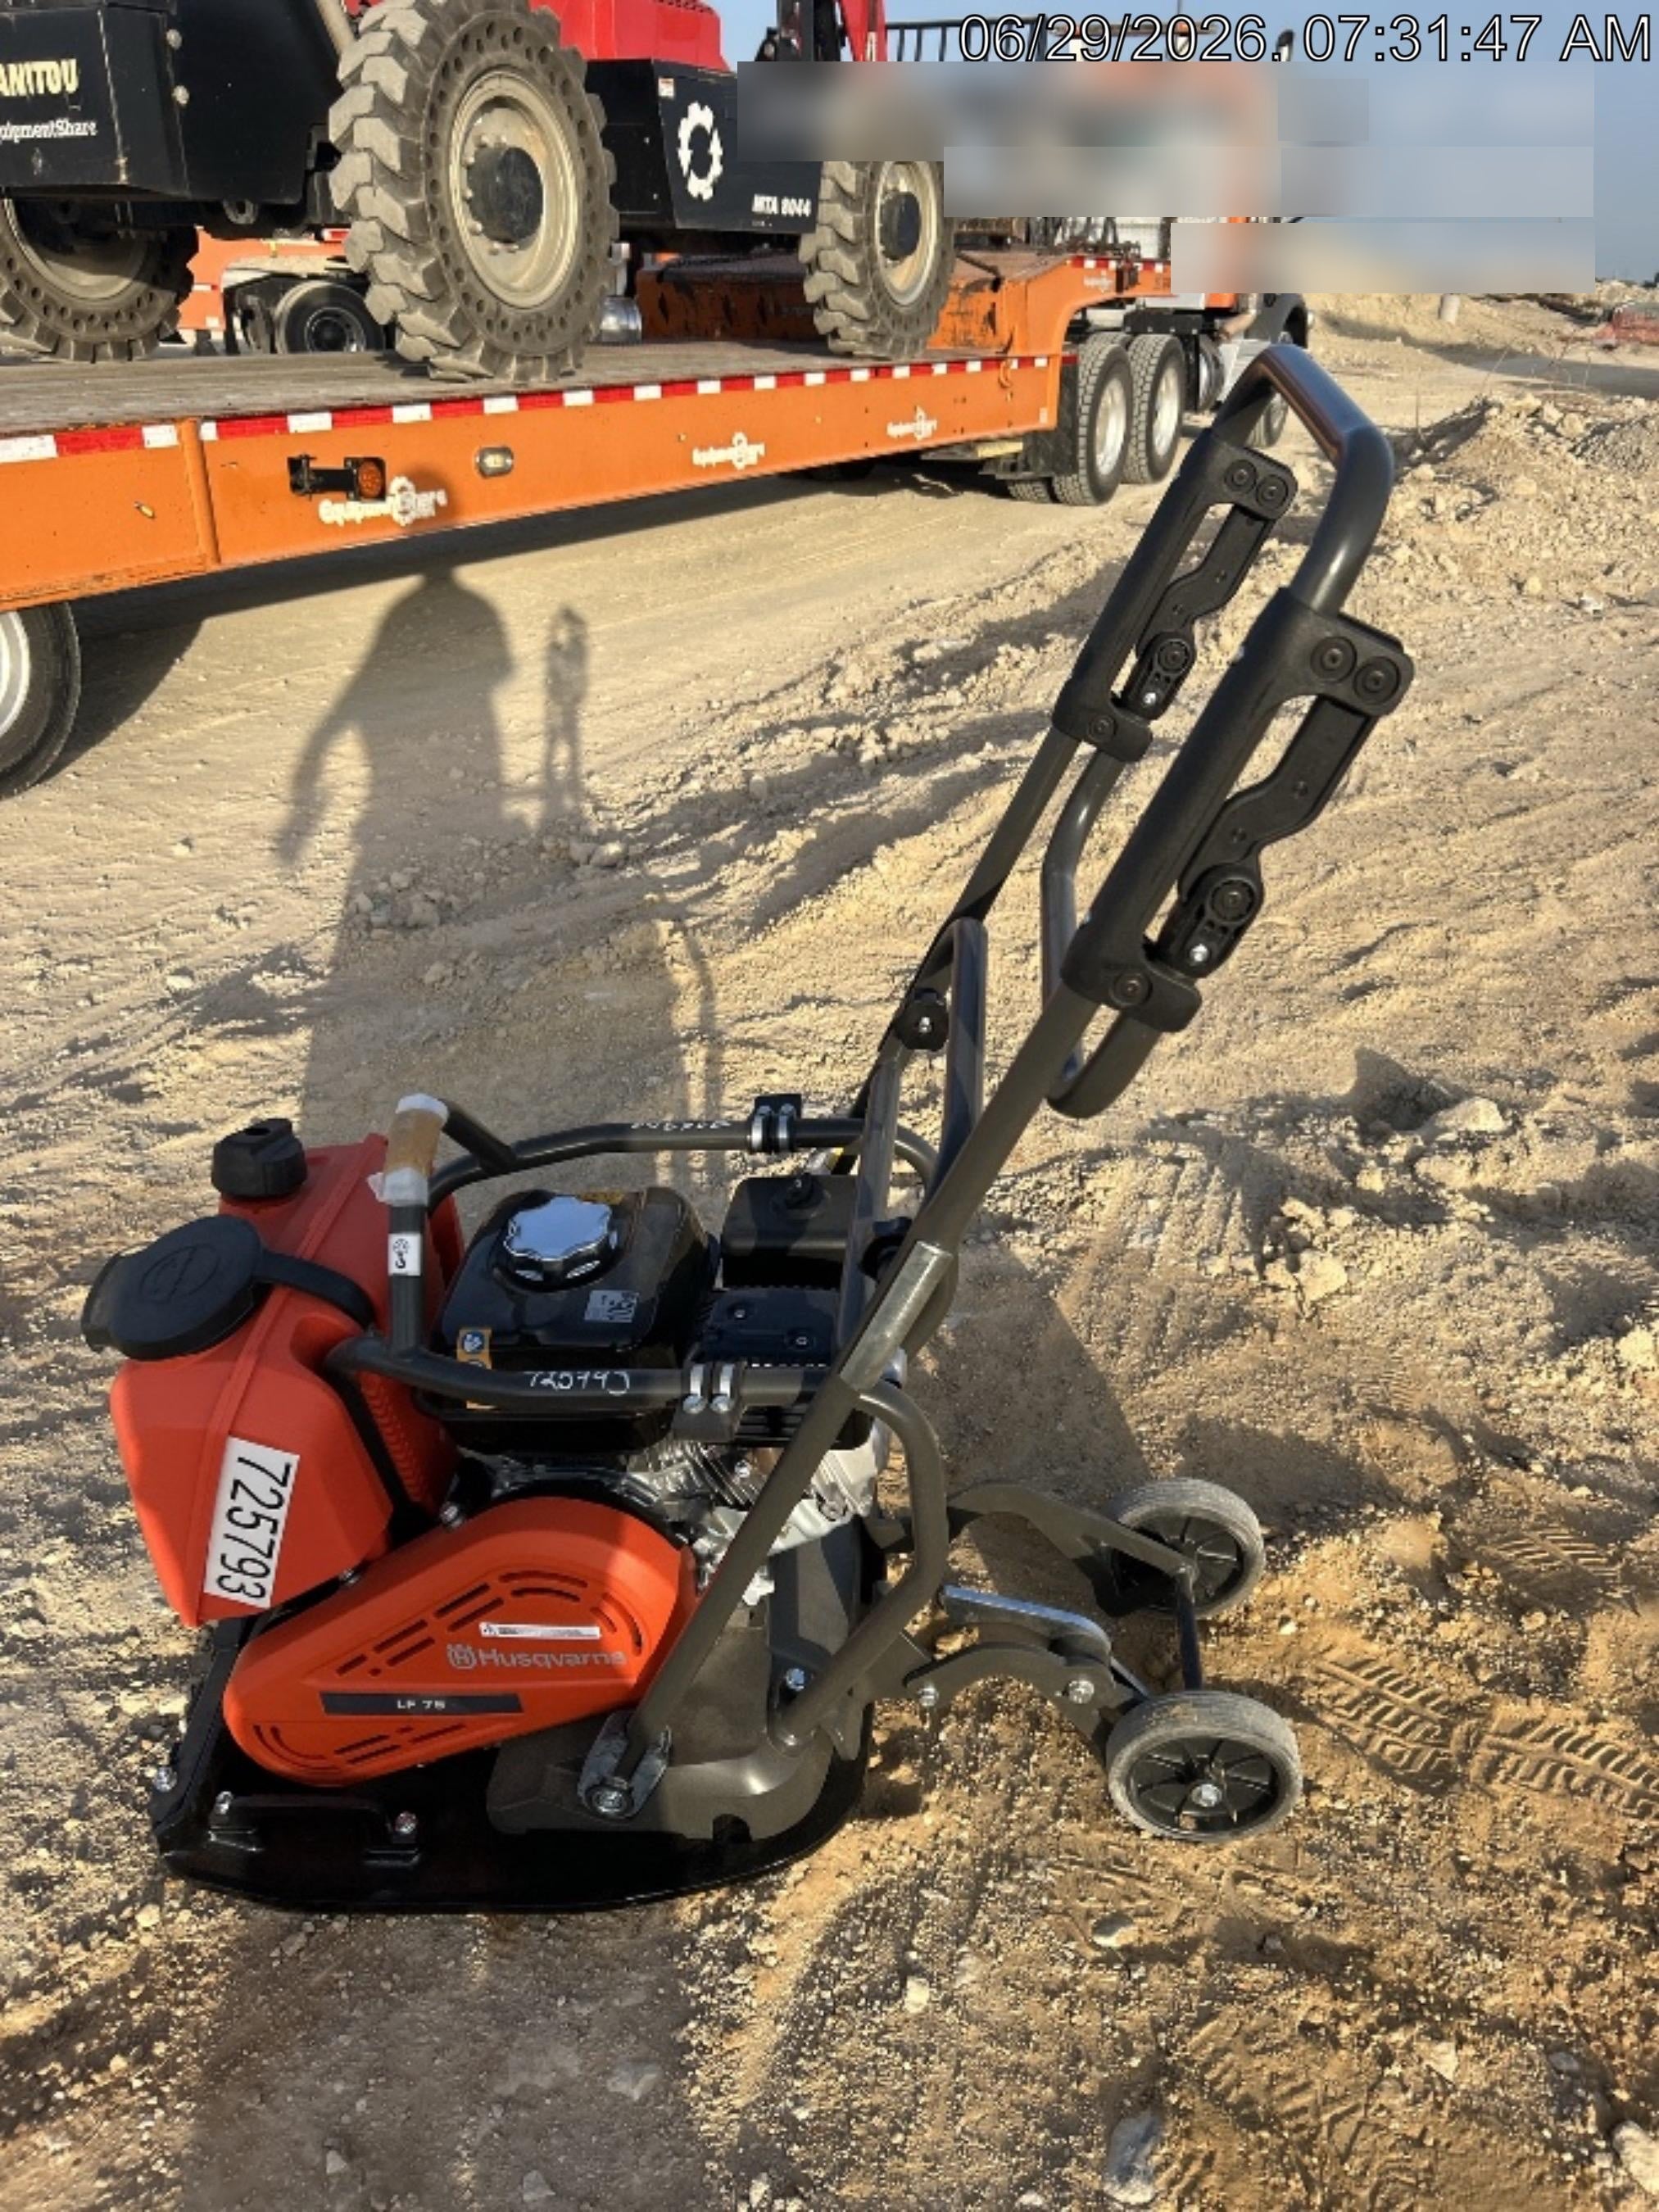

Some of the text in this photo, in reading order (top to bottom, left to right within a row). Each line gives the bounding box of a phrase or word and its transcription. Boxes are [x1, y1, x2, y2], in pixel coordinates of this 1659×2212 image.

[216, 1456, 292, 1598] 725793
[478, 1648, 628, 1669] Husqvarna
[397, 1699, 416, 1710] LF
